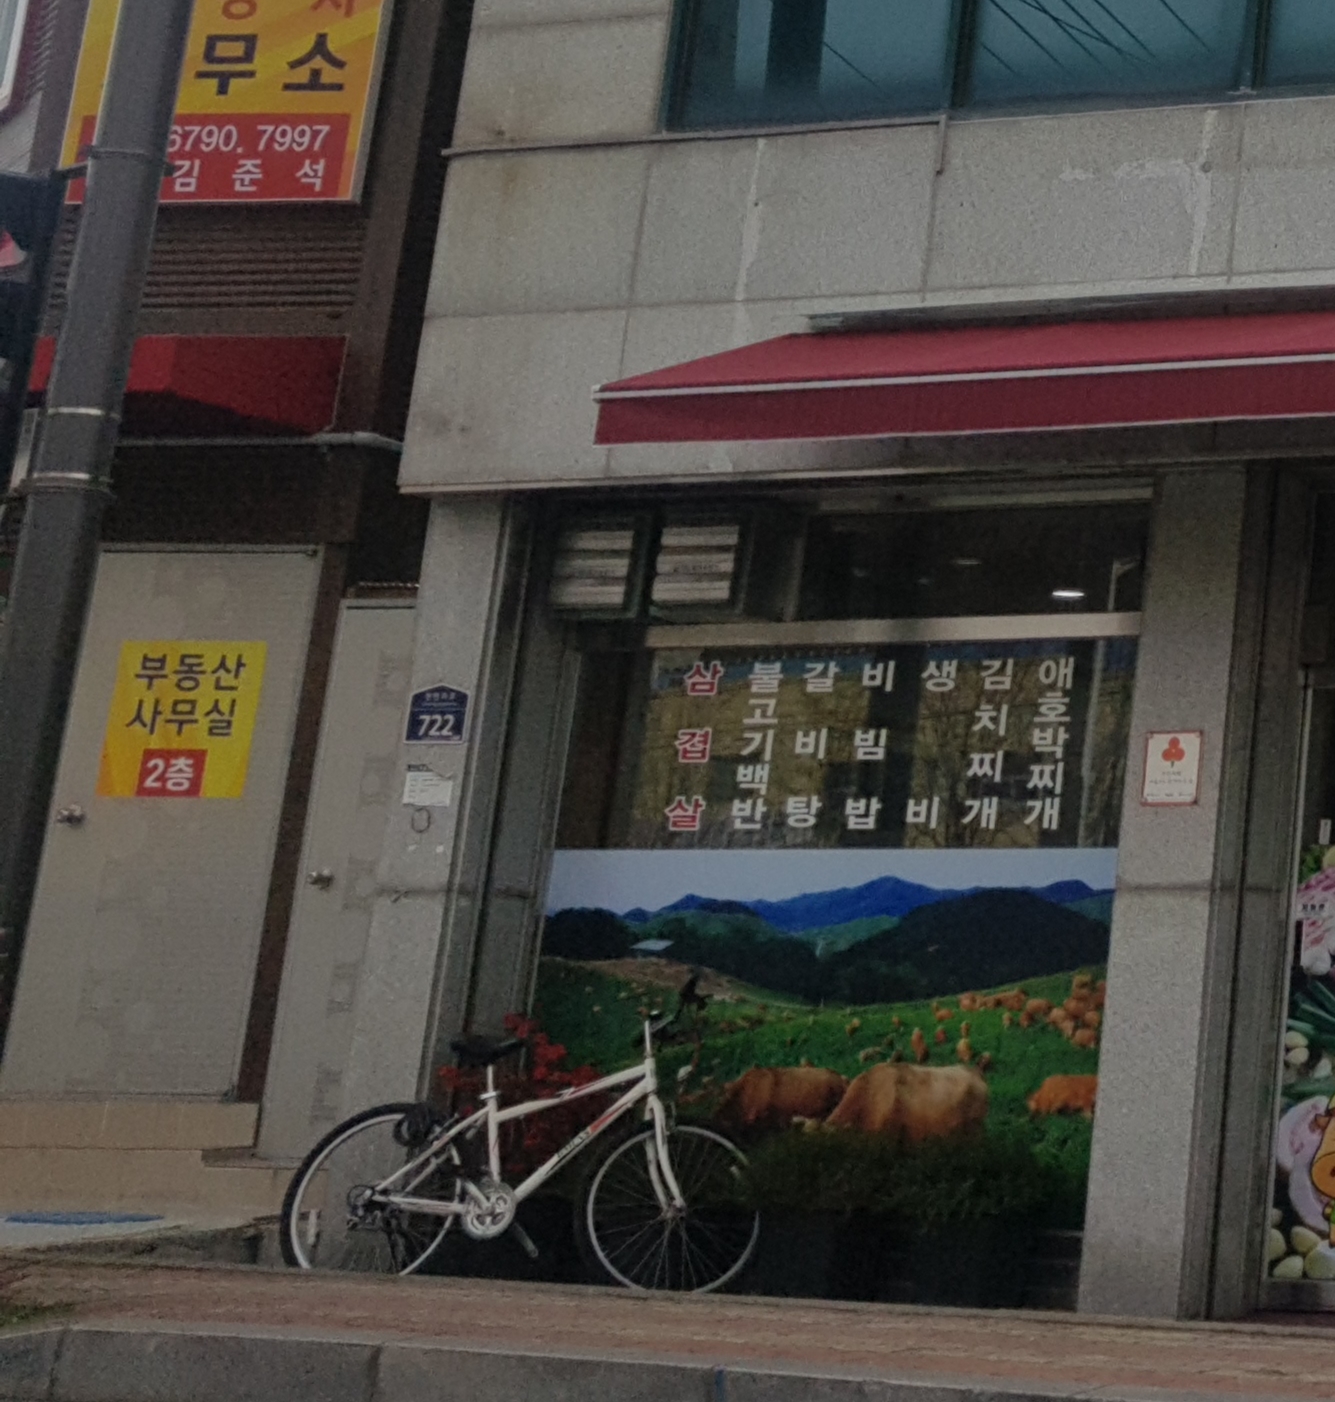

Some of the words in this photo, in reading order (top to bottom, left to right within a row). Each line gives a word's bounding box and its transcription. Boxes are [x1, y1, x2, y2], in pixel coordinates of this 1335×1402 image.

[125, 697, 238, 738] 사무실
[135, 653, 247, 693] 부동산
[418, 714, 455, 736] 722
[664, 661, 724, 832] 삼겹살
[731, 661, 784, 831] 불고기백반
[785, 660, 841, 830] 갈비탕
[844, 659, 896, 831] 비빔밥
[961, 658, 1014, 830] 김치찌개
[1024, 657, 1075, 830] 애호박찌개
[143, 758, 195, 792] 2층
